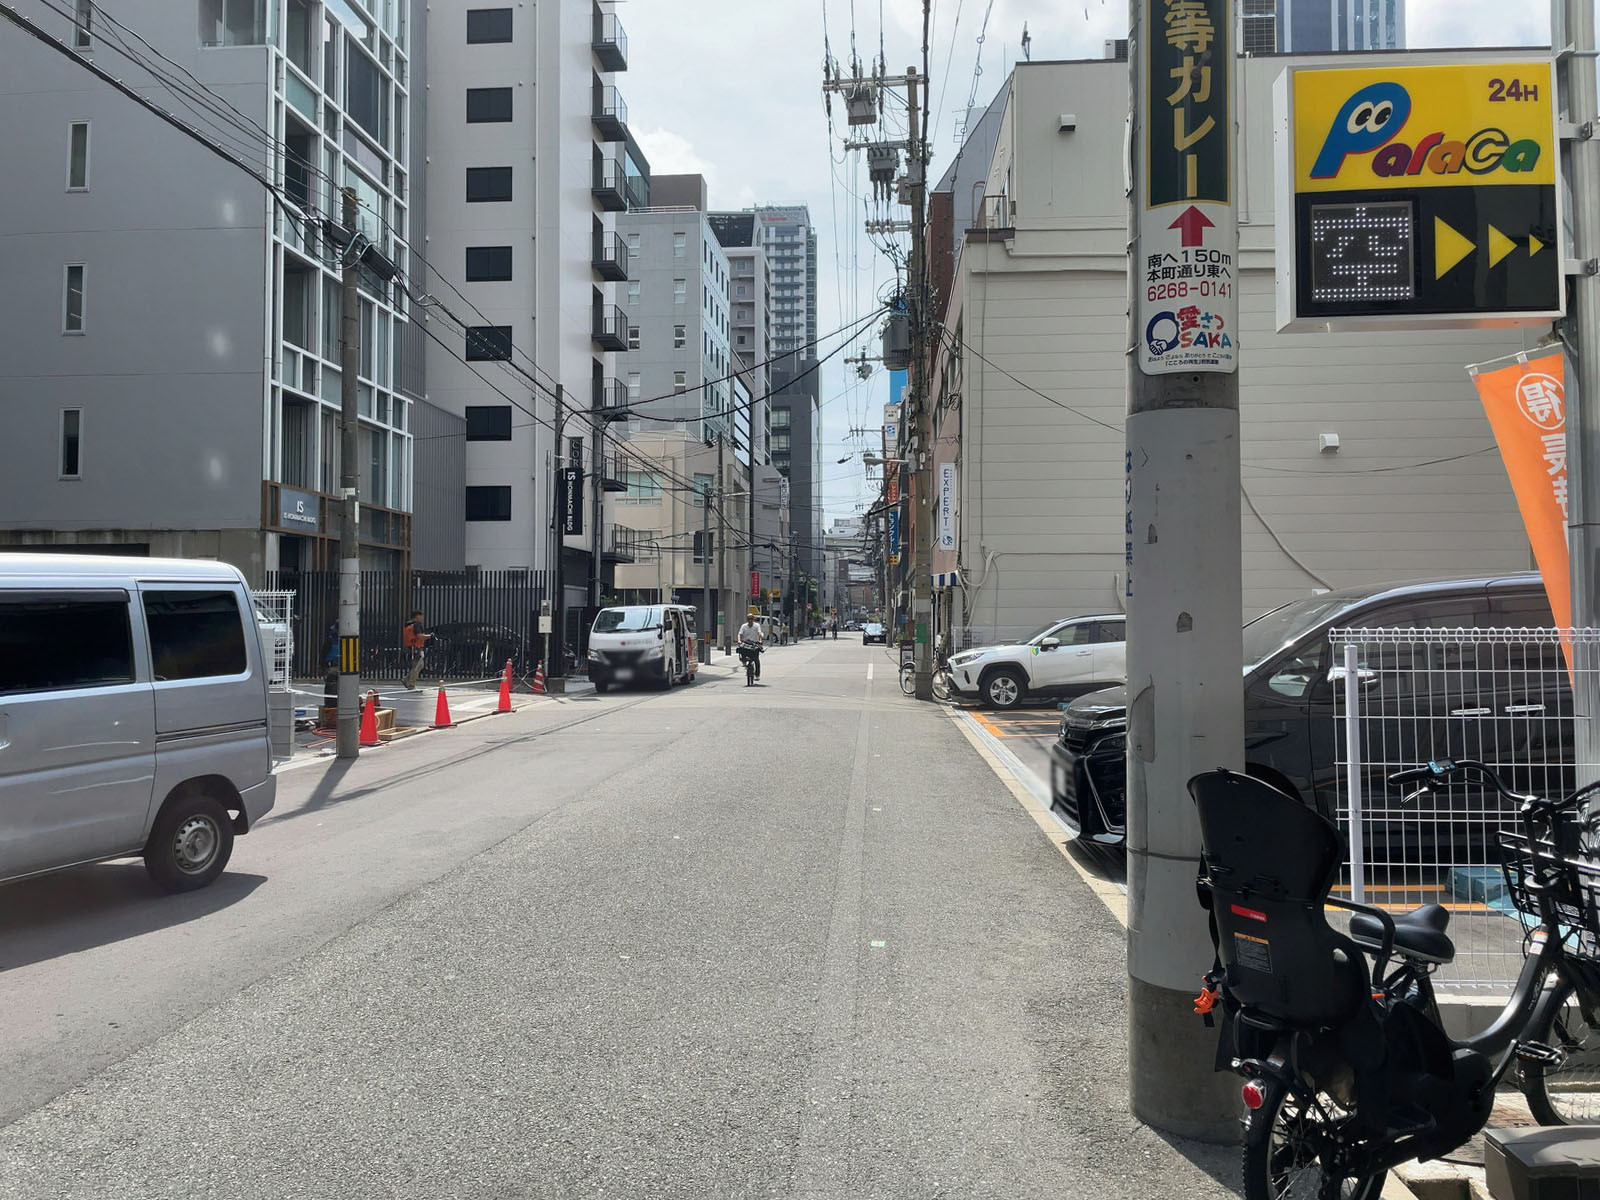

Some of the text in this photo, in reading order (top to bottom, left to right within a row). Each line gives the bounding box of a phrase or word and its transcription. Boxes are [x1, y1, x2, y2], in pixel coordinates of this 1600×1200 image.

[1488, 78, 1539, 102] 24H
[1147, 264, 1232, 283] 本町通り東へ
[1147, 280, 1232, 303] 6268-0141
